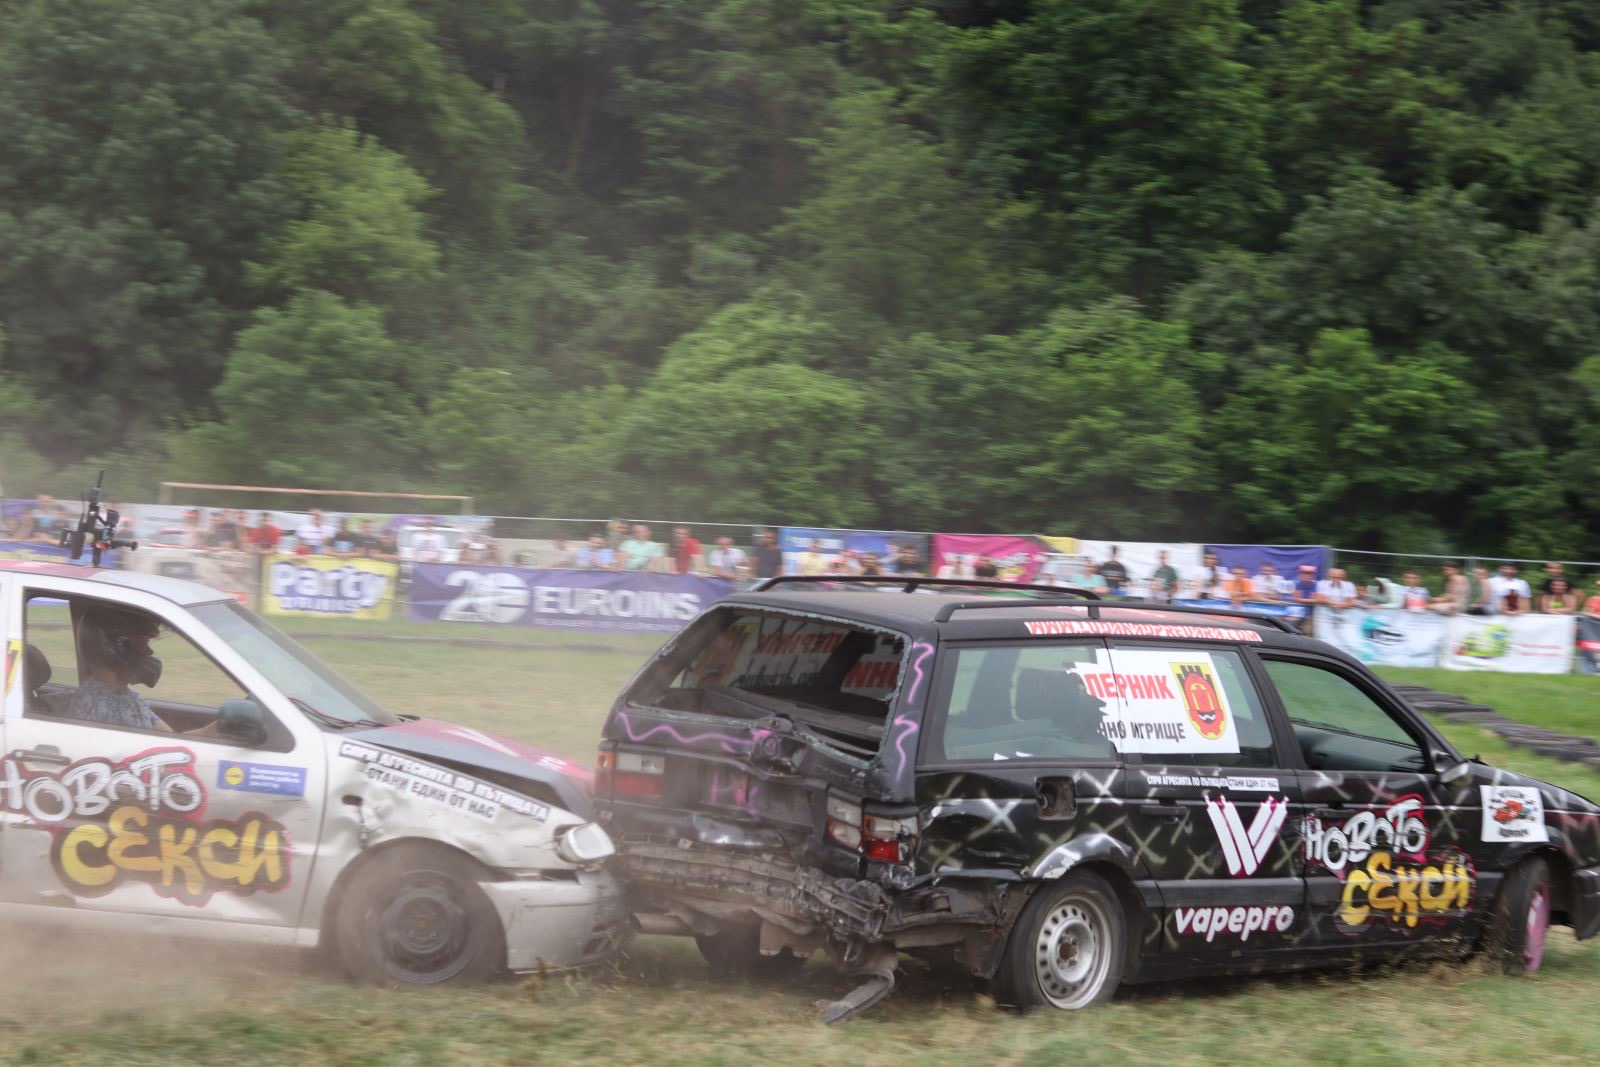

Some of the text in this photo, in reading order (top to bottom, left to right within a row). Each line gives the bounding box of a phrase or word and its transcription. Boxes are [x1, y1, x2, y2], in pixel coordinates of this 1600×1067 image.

[533, 586, 701, 621] EUROINS
[1083, 673, 1176, 699] ПЕРНИК
[1130, 721, 1186, 743] ИГРИЩЕ
[411, 781, 447, 802] ЕДИН
[449, 793, 467, 808] ОТ
[468, 798, 496, 819] НАС
[1175, 905, 1295, 942] vapepro
